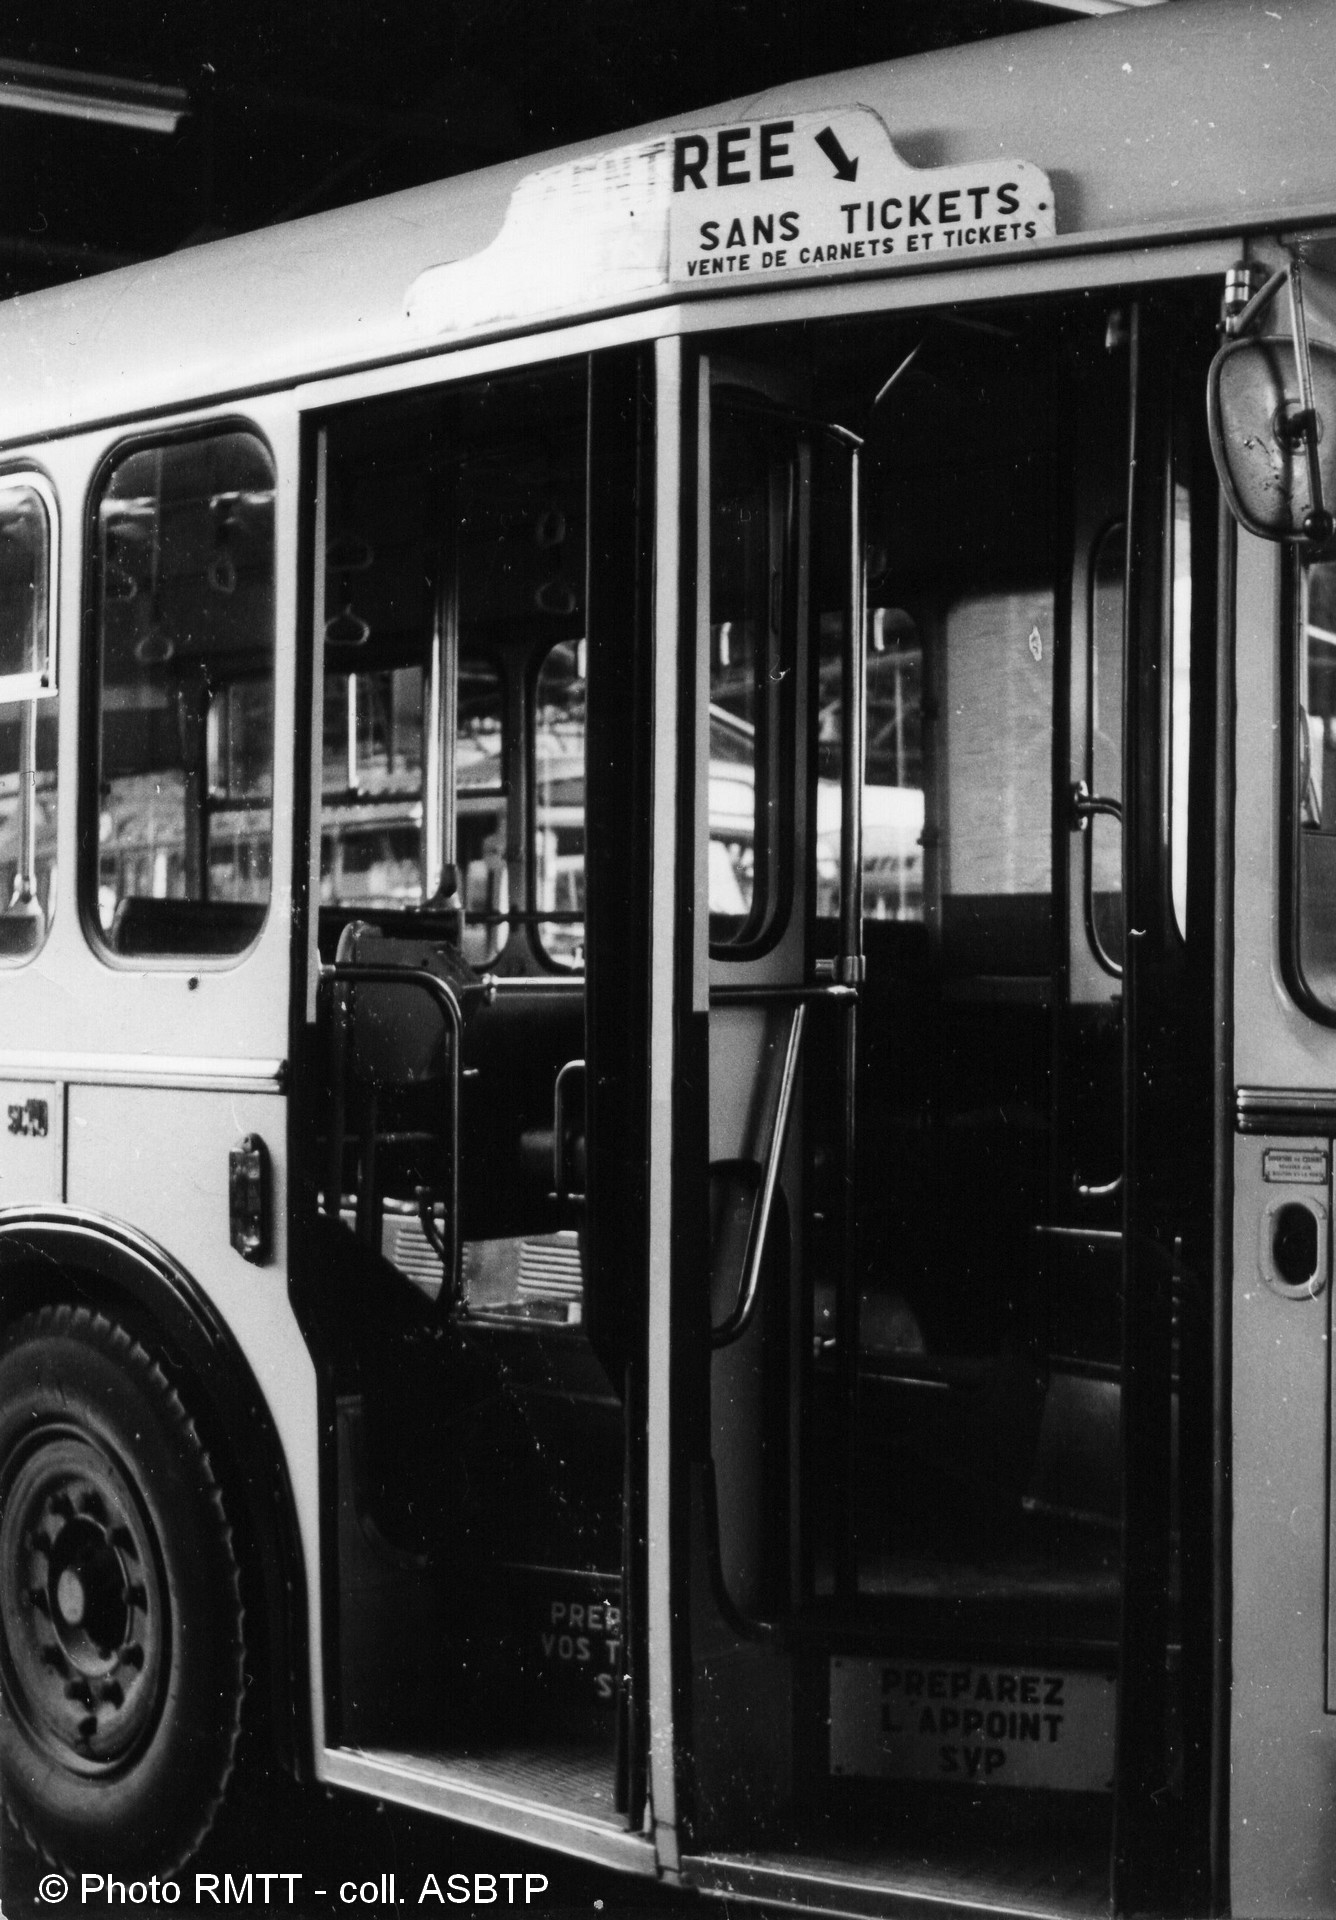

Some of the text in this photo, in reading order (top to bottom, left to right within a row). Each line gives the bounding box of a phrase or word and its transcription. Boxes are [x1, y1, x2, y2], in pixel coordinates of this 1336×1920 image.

[699, 182, 1020, 251] SANS TICKETS
[687, 221, 1038, 277] VENTE DE CARNETS ET TICKETS
[541, 1633, 591, 1661] VOS
[881, 1667, 1065, 1706] PREPAREZ
[938, 1745, 1007, 1777] SVP
